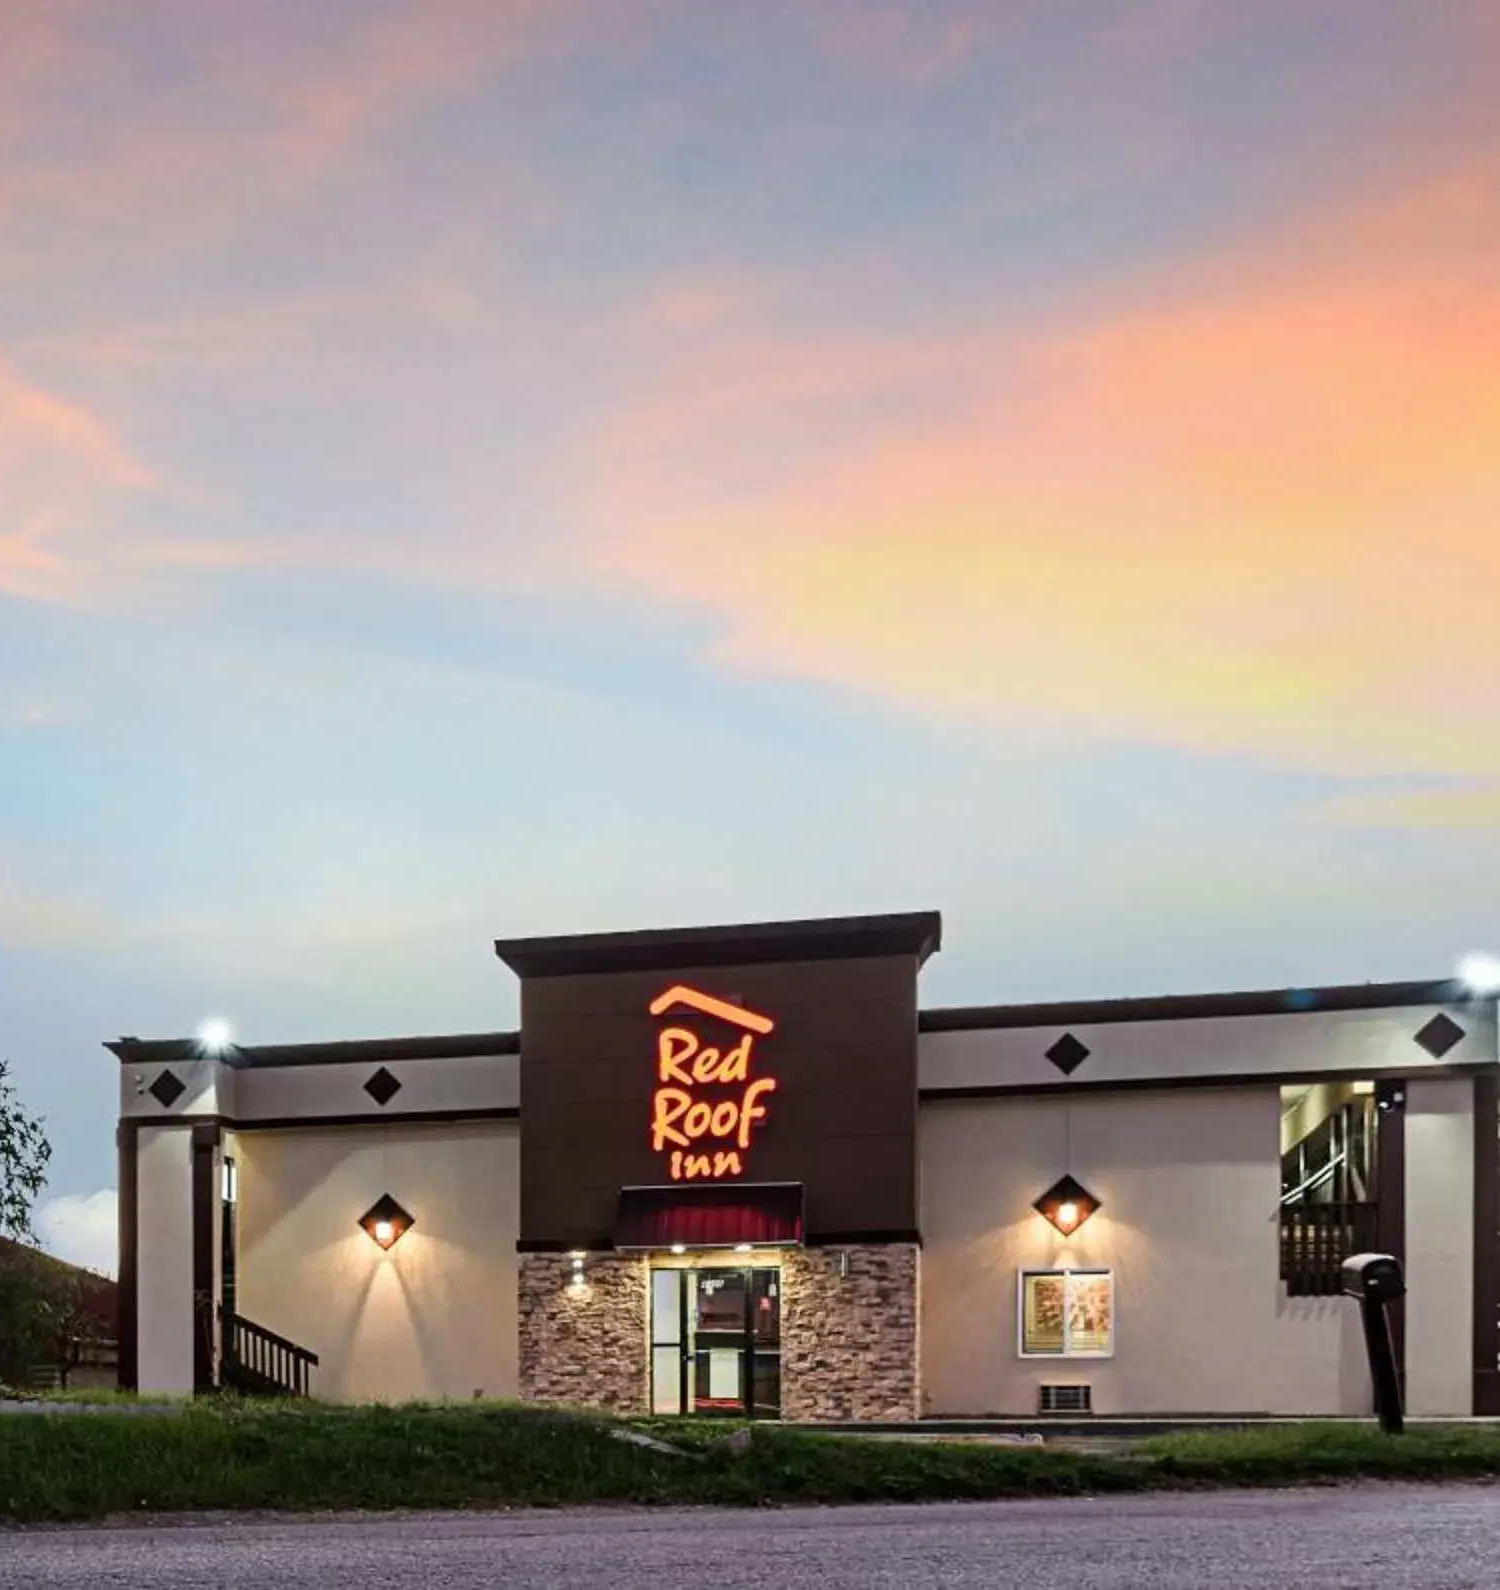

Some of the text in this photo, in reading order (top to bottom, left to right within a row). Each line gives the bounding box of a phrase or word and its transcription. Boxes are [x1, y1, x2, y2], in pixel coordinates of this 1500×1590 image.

[659, 1027, 753, 1086] Red
[652, 1077, 776, 1151] Roof
[670, 1150, 742, 1181] Inn
